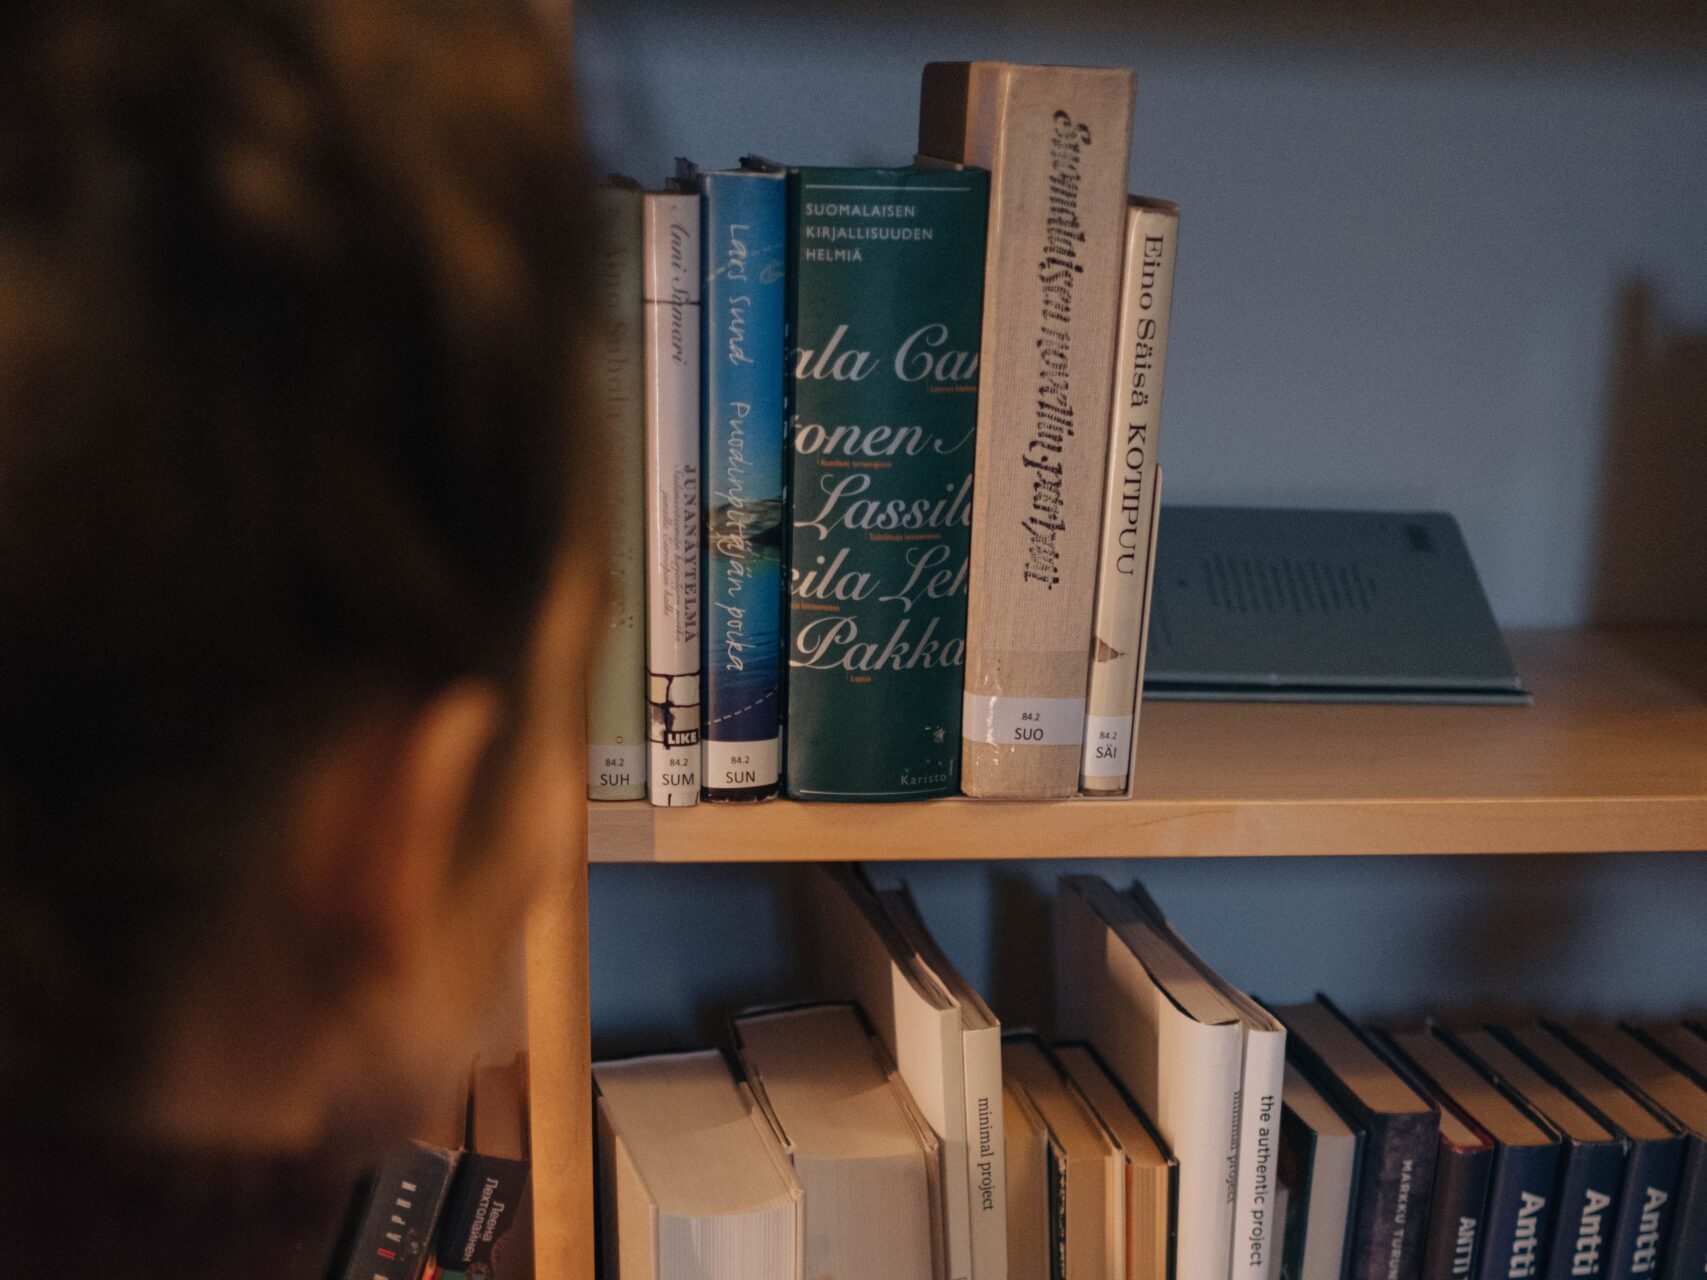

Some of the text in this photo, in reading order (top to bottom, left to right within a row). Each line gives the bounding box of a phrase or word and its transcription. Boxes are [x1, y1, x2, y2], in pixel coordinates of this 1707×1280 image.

[805, 203, 916, 218] SUOMALAISEN
[805, 226, 934, 242] KIRJALLISUUDEN
[805, 247, 863, 262] HELMIÄ
[1116, 235, 1165, 577] Eino Säisä KOTIPUU
[714, 224, 761, 672] Lars Sund Puodinpitäjän poika
[683, 465, 699, 643] JUNANÄYTELMÄ
[1021, 713, 1041, 722] 84.2
[667, 732, 698, 746] LIKE
[1013, 727, 1045, 742] SUO
[1098, 731, 1118, 741] 84.2
[1096, 744, 1118, 759] SÄI
[604, 758, 626, 768] 84.2
[668, 758, 690, 768] 84.2
[730, 755, 751, 765] 84.2
[599, 773, 631, 786] SUH
[661, 773, 696, 786] SUM
[725, 771, 757, 784] SUN
[900, 773, 947, 786] Karisto
[976, 1097, 996, 1213] minimal project
[1248, 1095, 1274, 1268] the authentic project
[1394, 1159, 1414, 1225] MARKKU
[462, 1177, 498, 1263] Лехтолайнен
[483, 1199, 505, 1242] Леена
[1508, 1189, 1547, 1279] Antti
[1571, 1187, 1612, 1277] Antti
[1631, 1185, 1669, 1274] Antti
[1452, 1215, 1477, 1274] ANTTI
